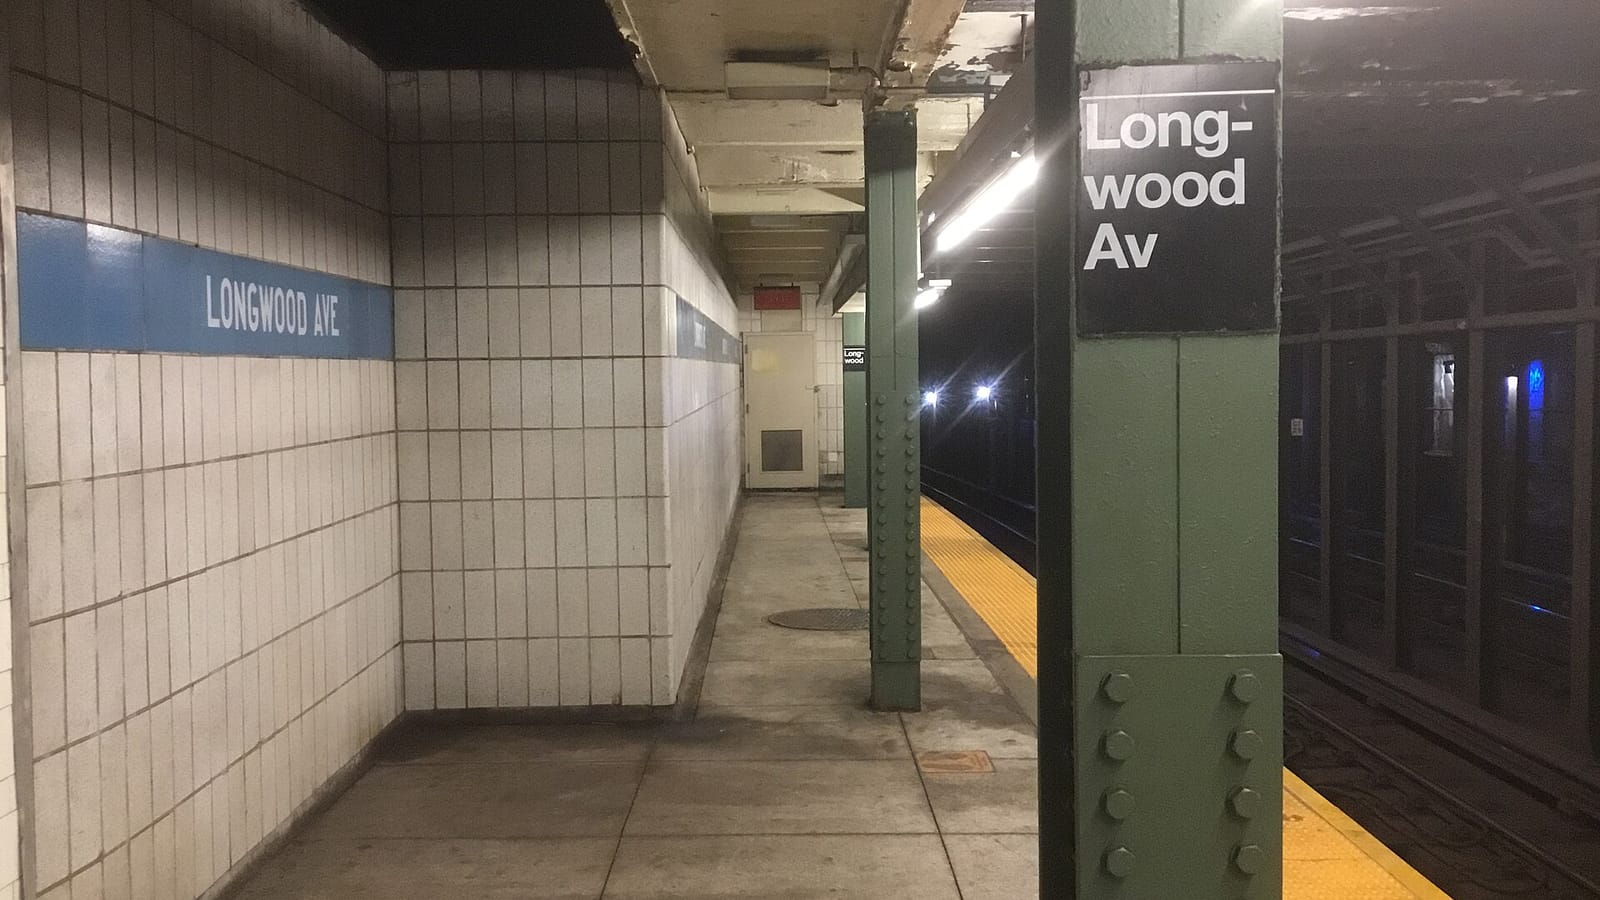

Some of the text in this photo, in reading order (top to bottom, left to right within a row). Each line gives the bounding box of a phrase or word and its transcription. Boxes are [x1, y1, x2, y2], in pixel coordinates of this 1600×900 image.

[1086, 103, 1253, 158] Long-
[1083, 158, 1246, 210] wood
[1083, 222, 1159, 270] Av
[205, 274, 340, 337] LONGWOOD AVE
[844, 356, 864, 364] wood
